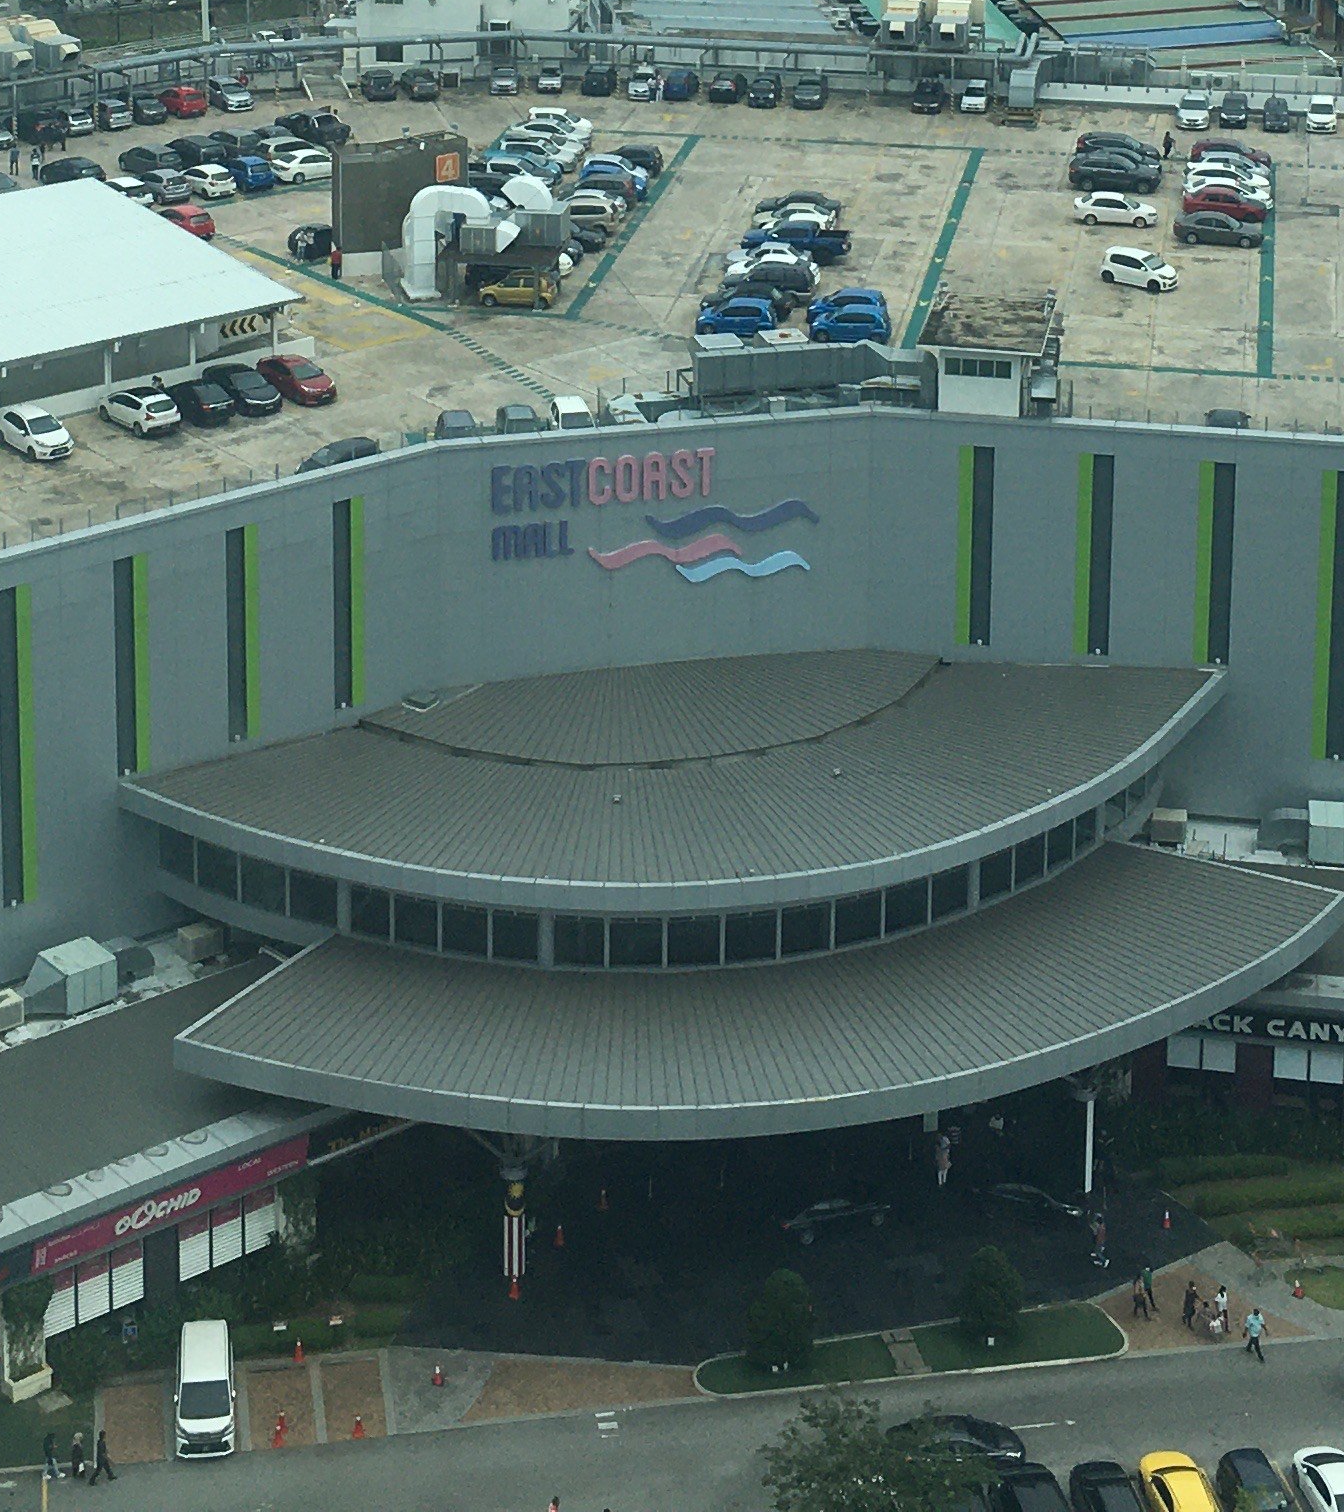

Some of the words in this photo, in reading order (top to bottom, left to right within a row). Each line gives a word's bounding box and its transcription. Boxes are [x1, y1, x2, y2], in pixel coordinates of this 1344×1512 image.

[441, 159, 456, 178] 4
[490, 520, 575, 562] MALL
[1193, 1014, 1255, 1034] ACK
